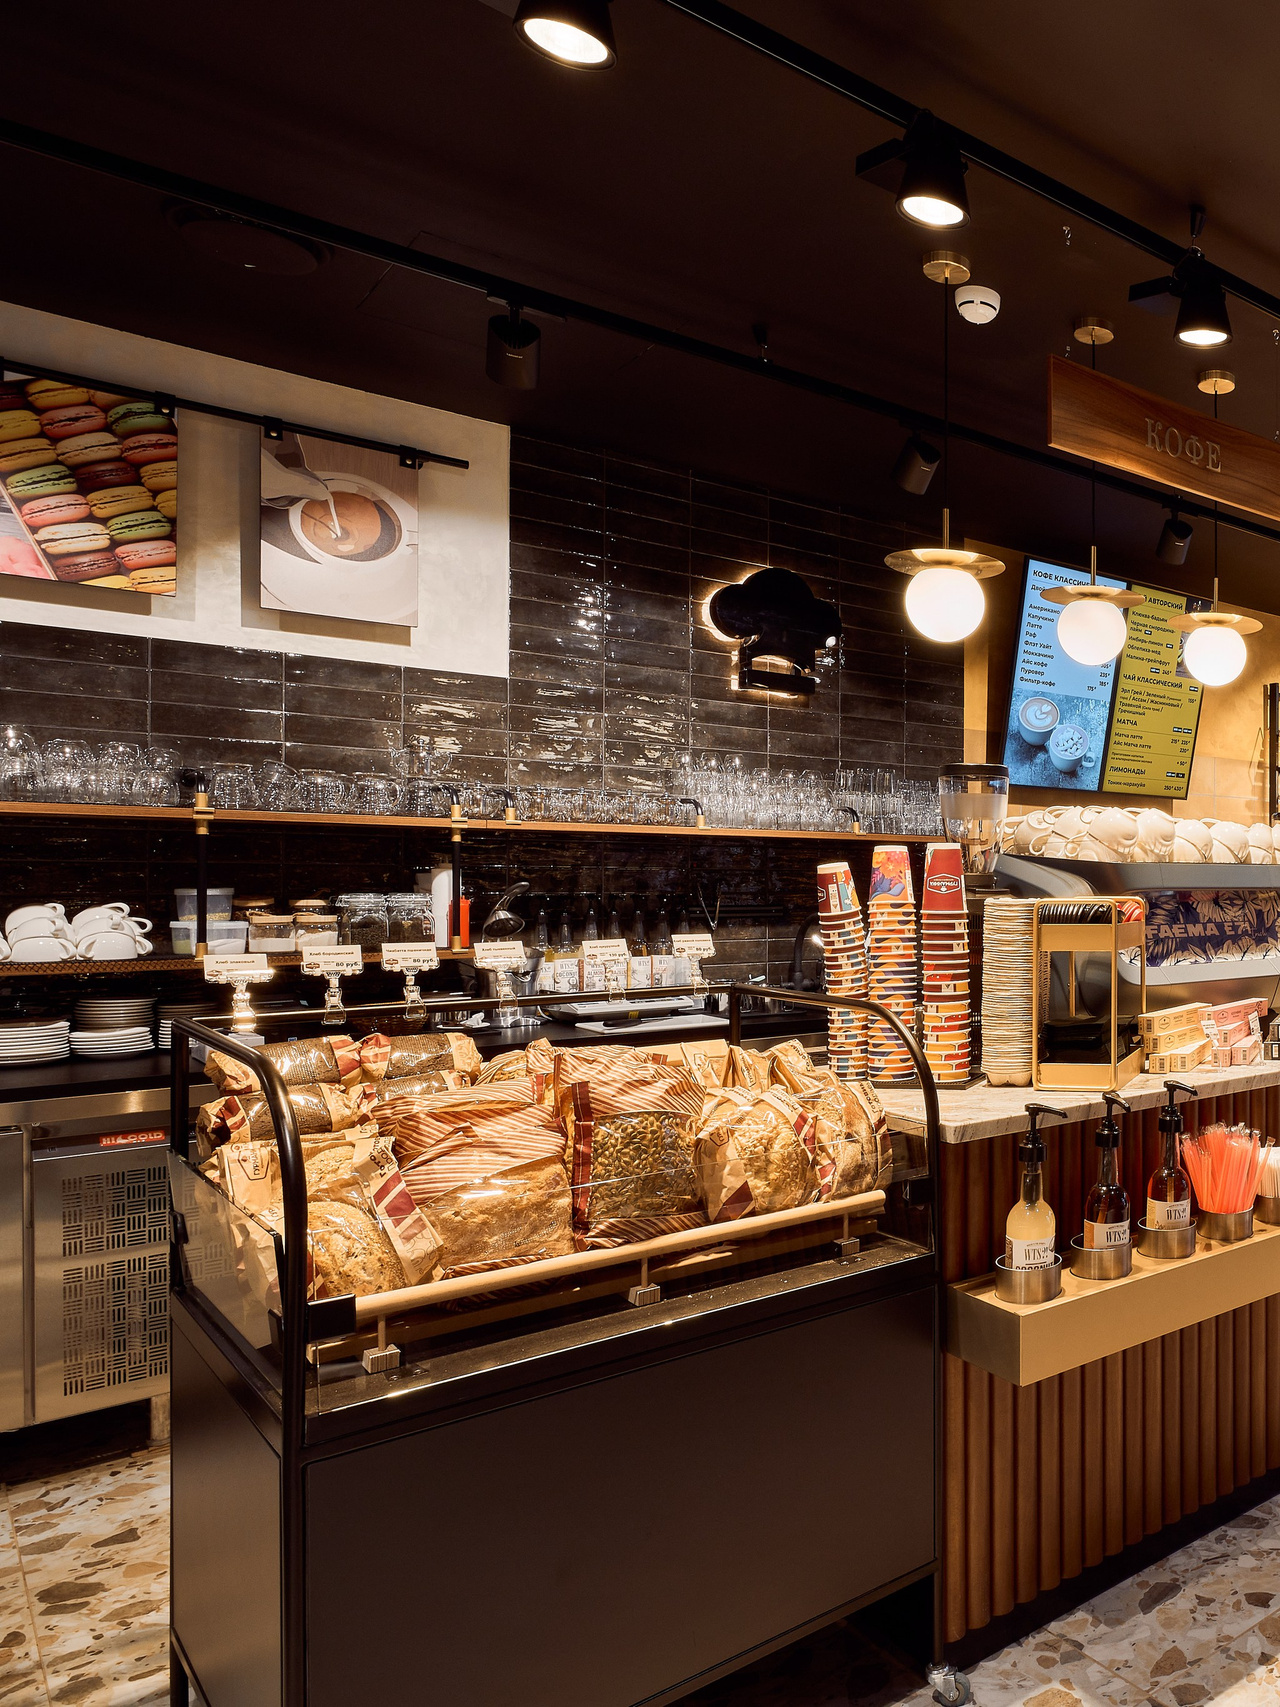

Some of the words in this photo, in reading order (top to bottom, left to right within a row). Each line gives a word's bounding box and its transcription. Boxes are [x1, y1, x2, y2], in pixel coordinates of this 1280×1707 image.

[1145, 418, 1221, 472] КОФЕ
[1033, 570, 1052, 580] КОФЕ
[1148, 597, 1183, 610] АВТОРСКИЙ
[1029, 604, 1060, 614] Американо
[1028, 612, 1054, 622] Капучино
[1021, 668, 1044, 676] Пуровер
[1020, 677, 1055, 687] Фильтр-кофе
[1137, 676, 1182, 688] КЛАССИЧЕСКИЙ
[1117, 718, 1137, 726] МАТЧА
[1109, 766, 1145, 774] ЛИМОНАДЫ
[1145, 921, 1220, 939] FAEMA
